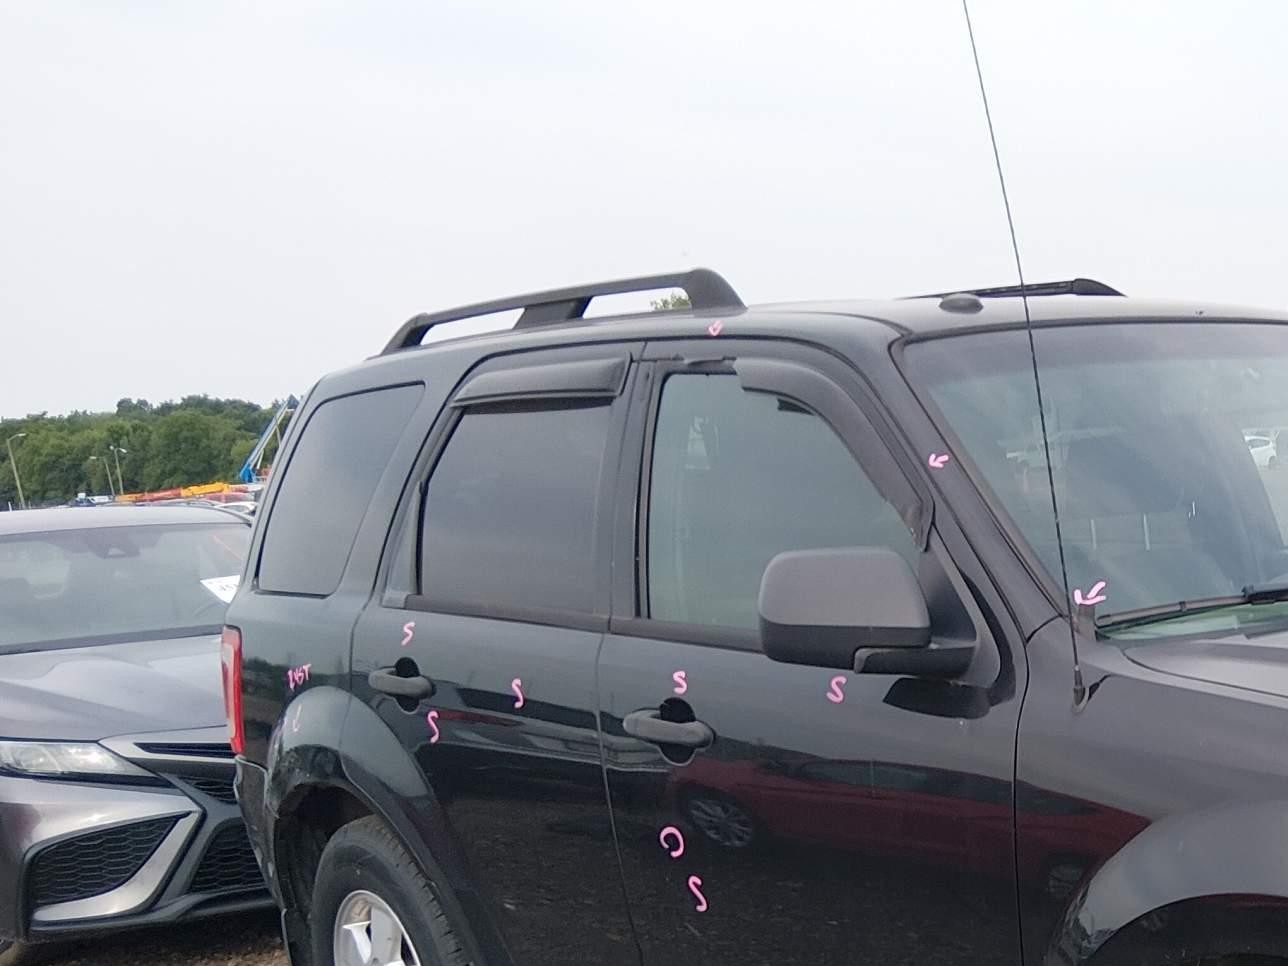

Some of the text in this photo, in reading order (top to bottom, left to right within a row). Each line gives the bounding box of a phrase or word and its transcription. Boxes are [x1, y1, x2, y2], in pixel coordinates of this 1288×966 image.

[401, 621, 416, 646] S
[672, 670, 688, 694] S
[826, 675, 847, 703] S
